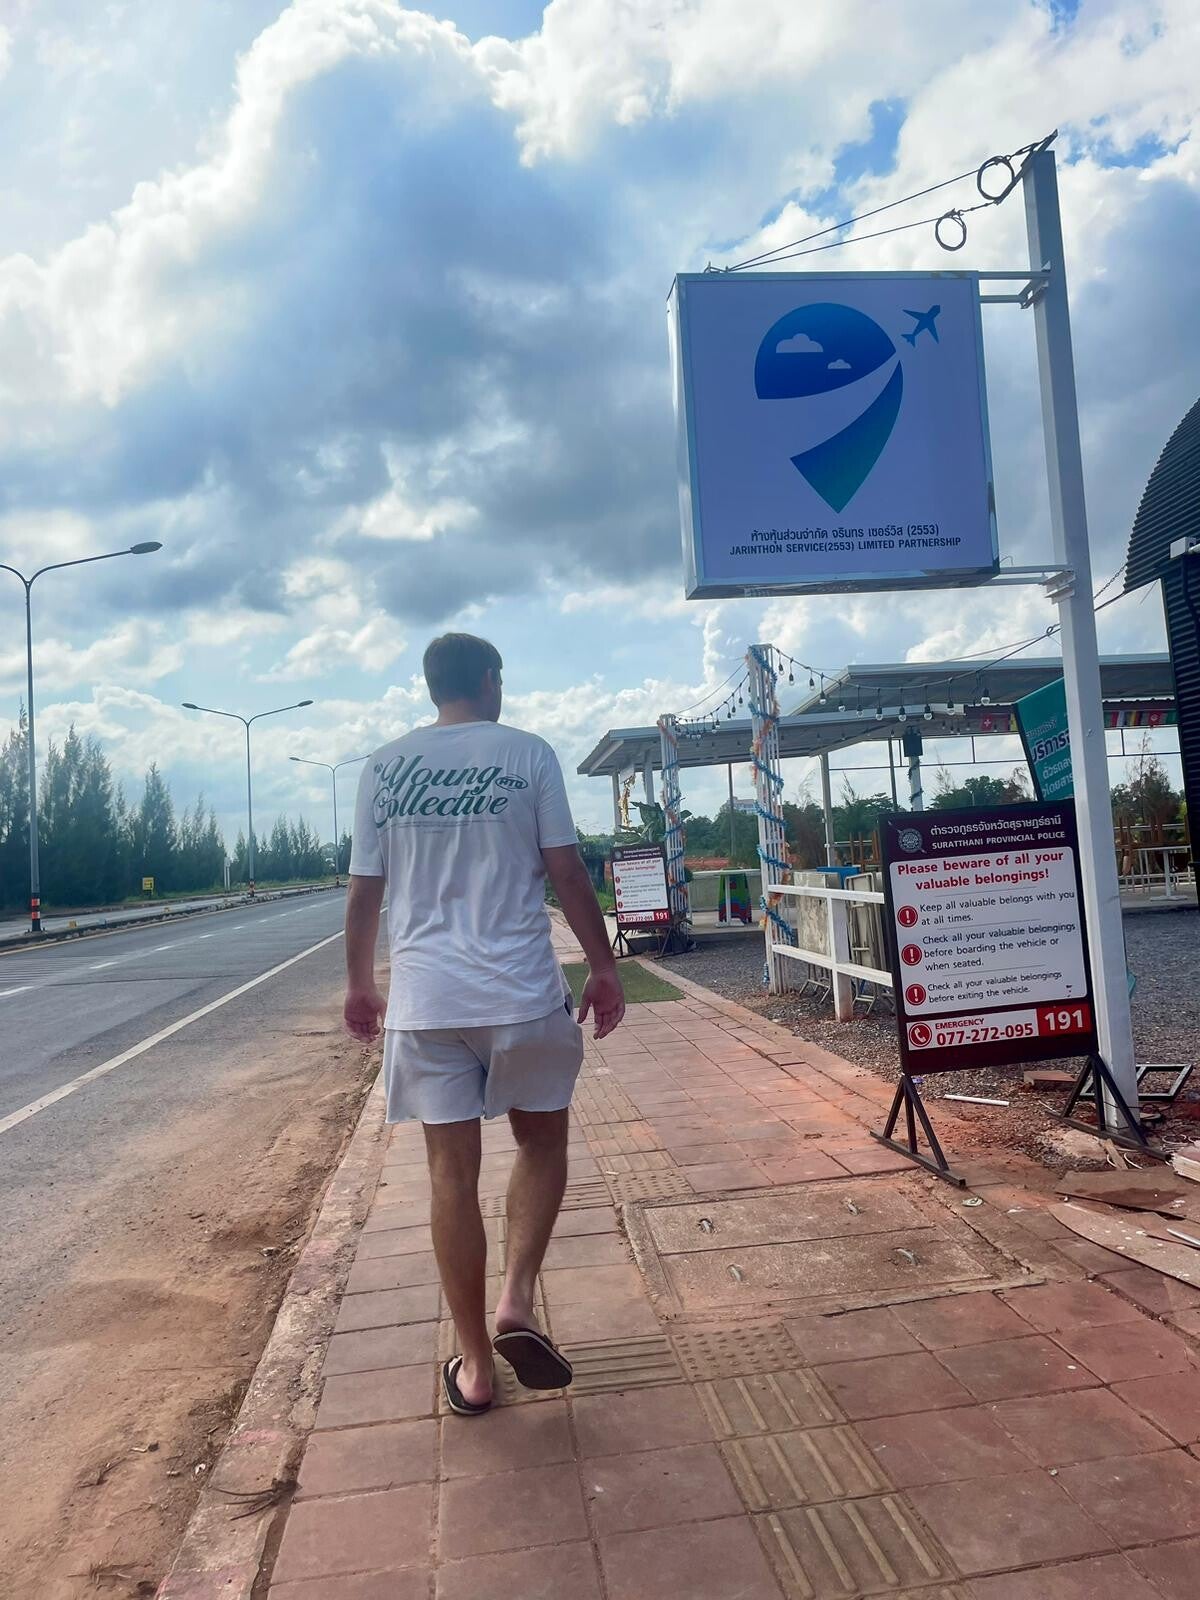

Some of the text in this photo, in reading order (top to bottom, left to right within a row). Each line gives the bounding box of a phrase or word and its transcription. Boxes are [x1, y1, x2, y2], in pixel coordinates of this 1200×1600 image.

[751, 529, 827, 544] ห้างหุ้นส่วนจำกัด
[869, 525, 903, 536] เซอร์วิส
[907, 524, 939, 537] (2553)
[730, 537, 961, 555] JARINTHON SERVICE(2553) LIMITED PARTNERSHIP
[374, 785, 508, 828] Collective
[930, 815, 1061, 836] ตำรวจภูธรจังหวัดสุราษฎร์ธานี
[932, 831, 1065, 849] SURATTHANI PROVINCIAL POLICE
[898, 852, 1064, 875] Please beware of all your
[916, 869, 1049, 890] valuable belongings!
[920, 891, 1074, 914] Keep all valuable belongs with you
[934, 916, 945, 924] all
[948, 914, 974, 923] times.
[923, 924, 1076, 945] Check all your valuable belongings
[924, 948, 953, 958] before
[957, 944, 995, 956] boarding
[999, 941, 1013, 950] the
[1017, 938, 1046, 948] vehicle
[925, 959, 984, 972] when seated.
[928, 971, 1062, 991] Check all your valuable belongings
[929, 986, 1030, 1003] before exiting the vehicle.
[935, 1018, 984, 1029] EMERGENCY
[937, 1009, 1083, 1046] 077-272-095 191
